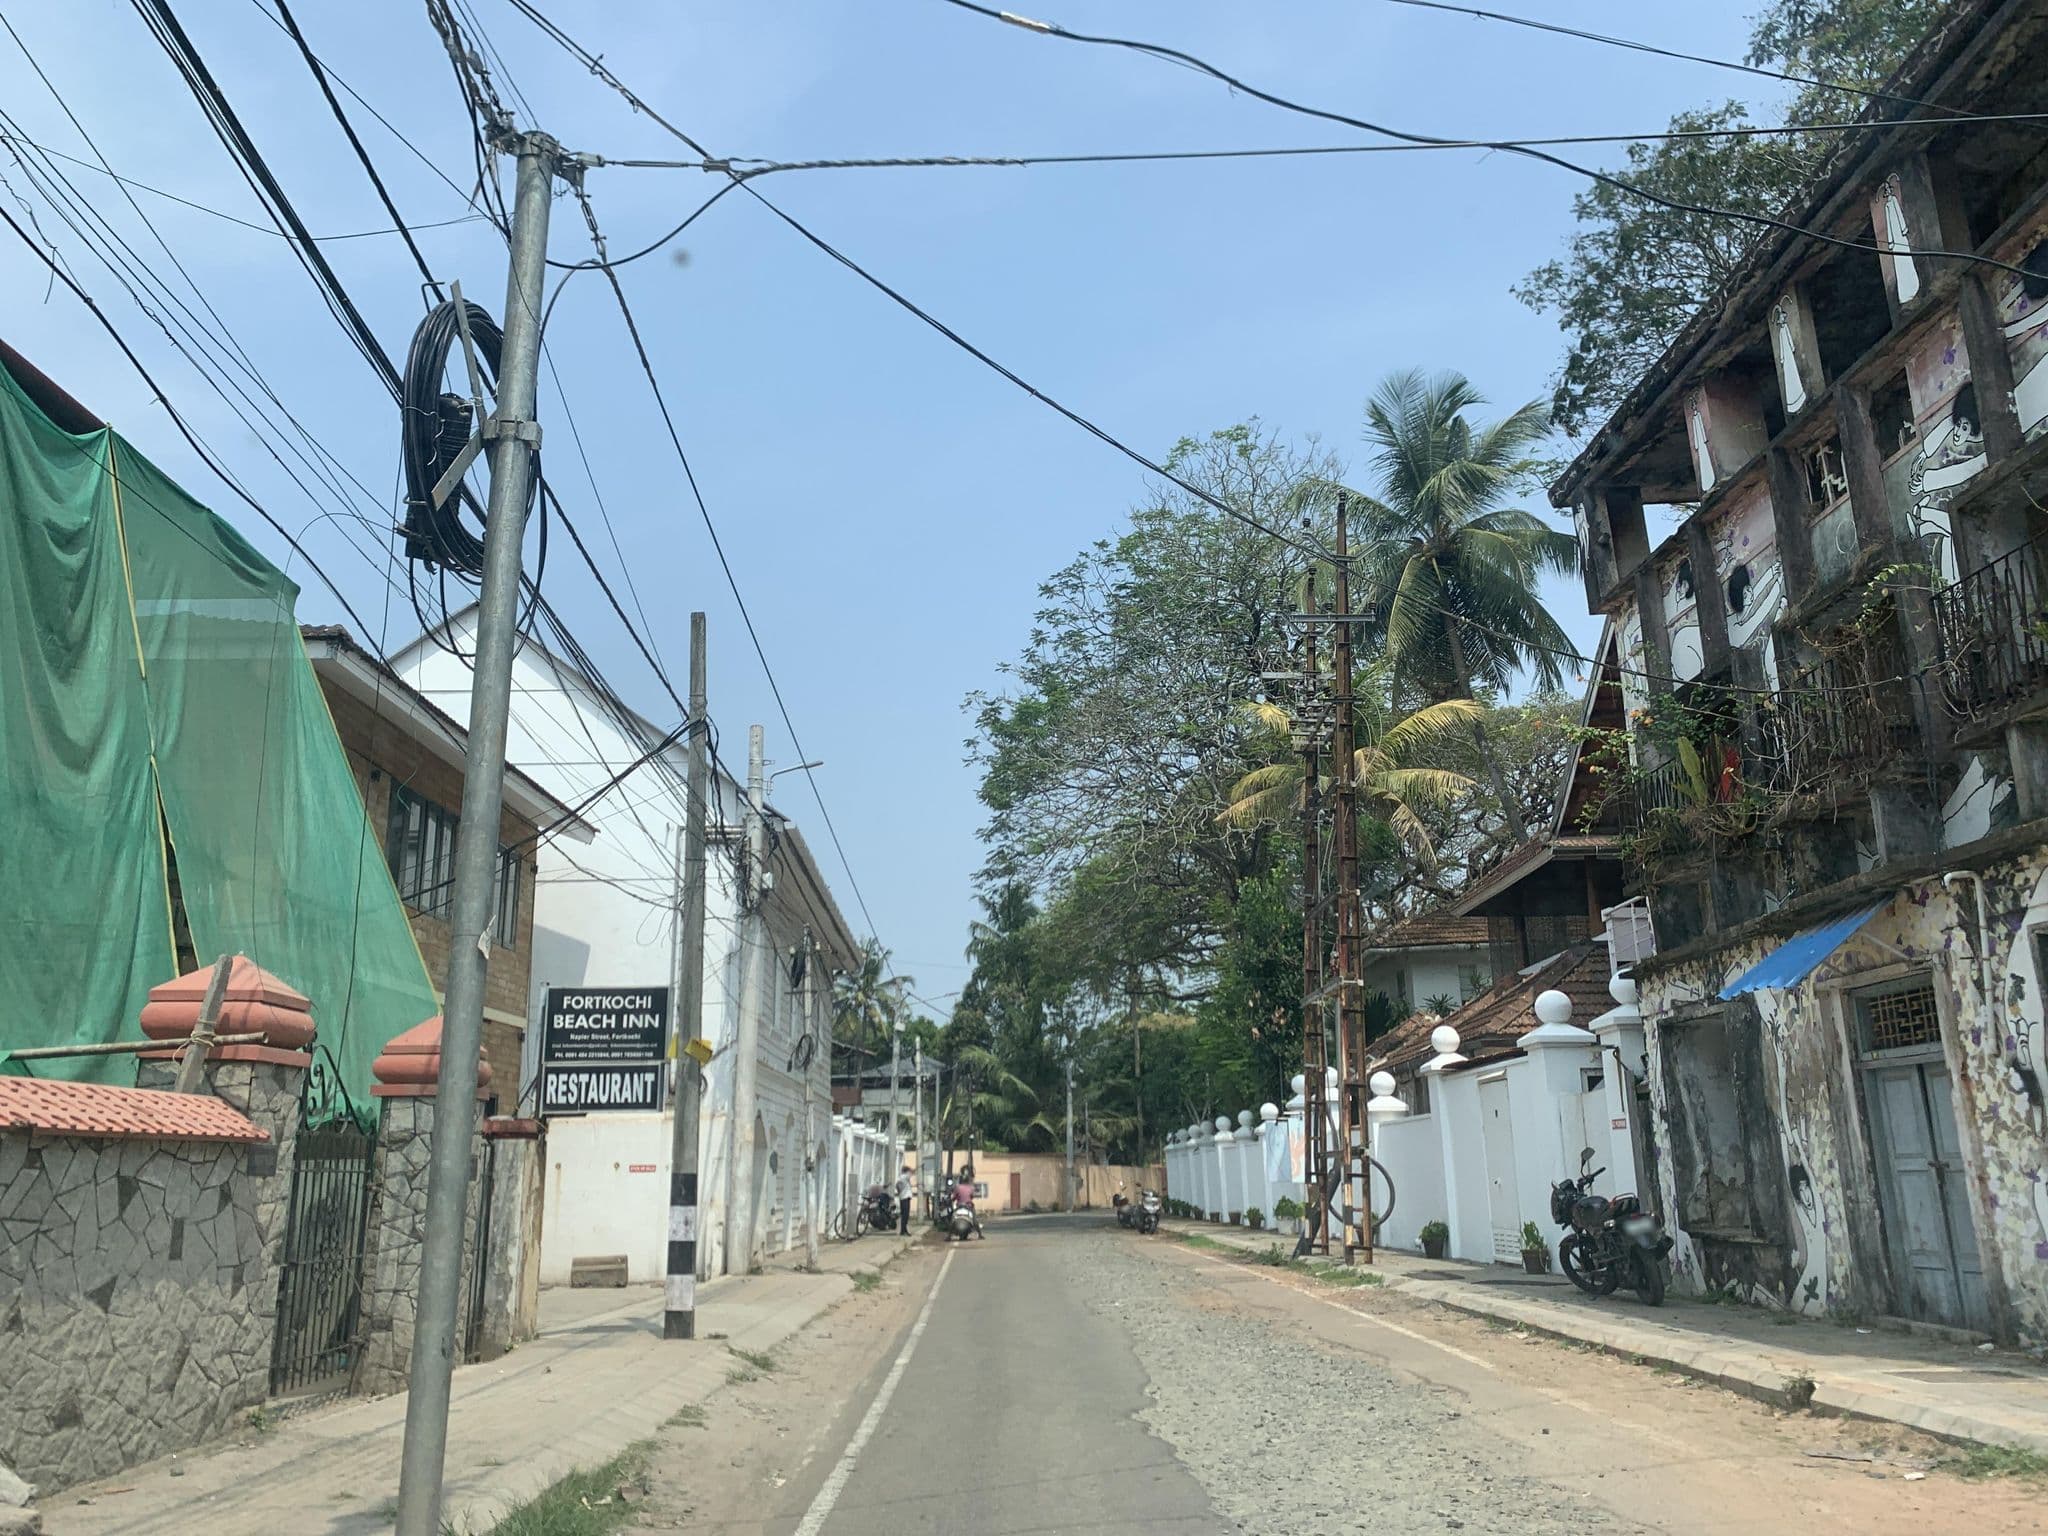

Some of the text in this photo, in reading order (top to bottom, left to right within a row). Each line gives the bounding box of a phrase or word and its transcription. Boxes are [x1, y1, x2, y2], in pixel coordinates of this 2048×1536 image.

[563, 995, 652, 1010] FORTKOCHI
[553, 1013, 660, 1029] BEACH INN
[546, 1072, 656, 1104] RESTAURANT
